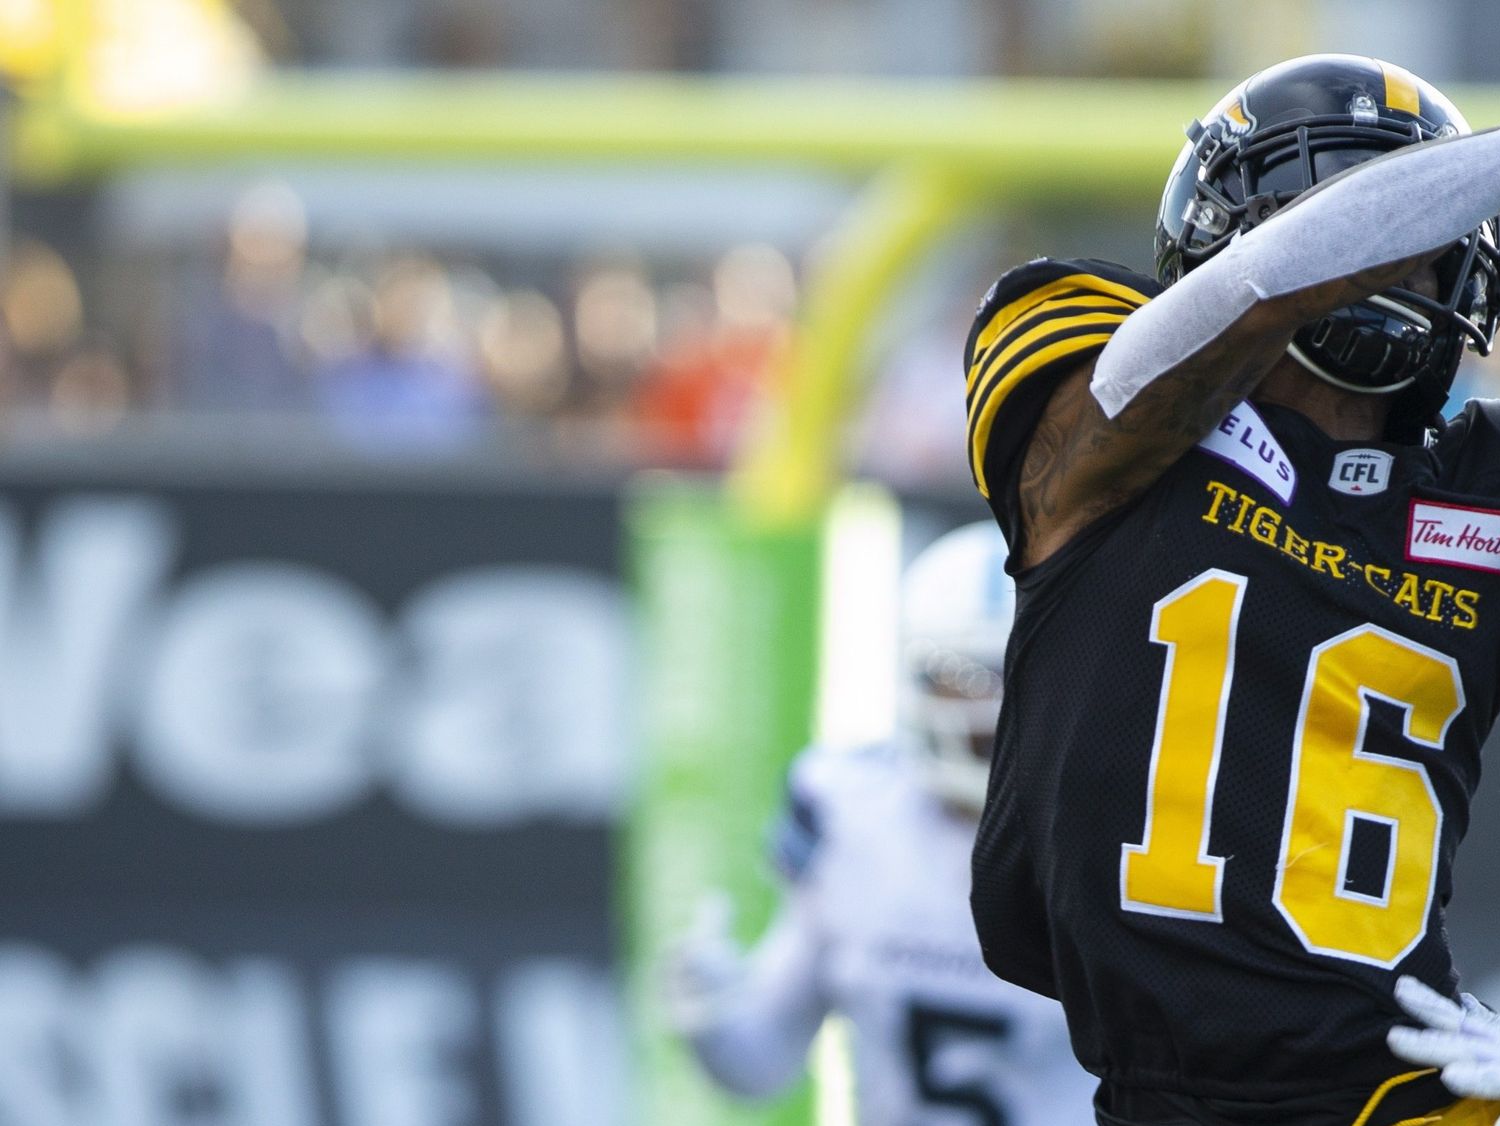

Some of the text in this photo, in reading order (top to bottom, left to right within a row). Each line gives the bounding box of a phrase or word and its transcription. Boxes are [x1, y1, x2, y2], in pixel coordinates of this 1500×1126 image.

[1218, 414, 1290, 482] ELUS
[1339, 461, 1380, 484] CFL
[1202, 480, 1481, 630] TIGER-CATS
[1414, 519, 1454, 548] Tim
[1120, 568, 1466, 970] 16
